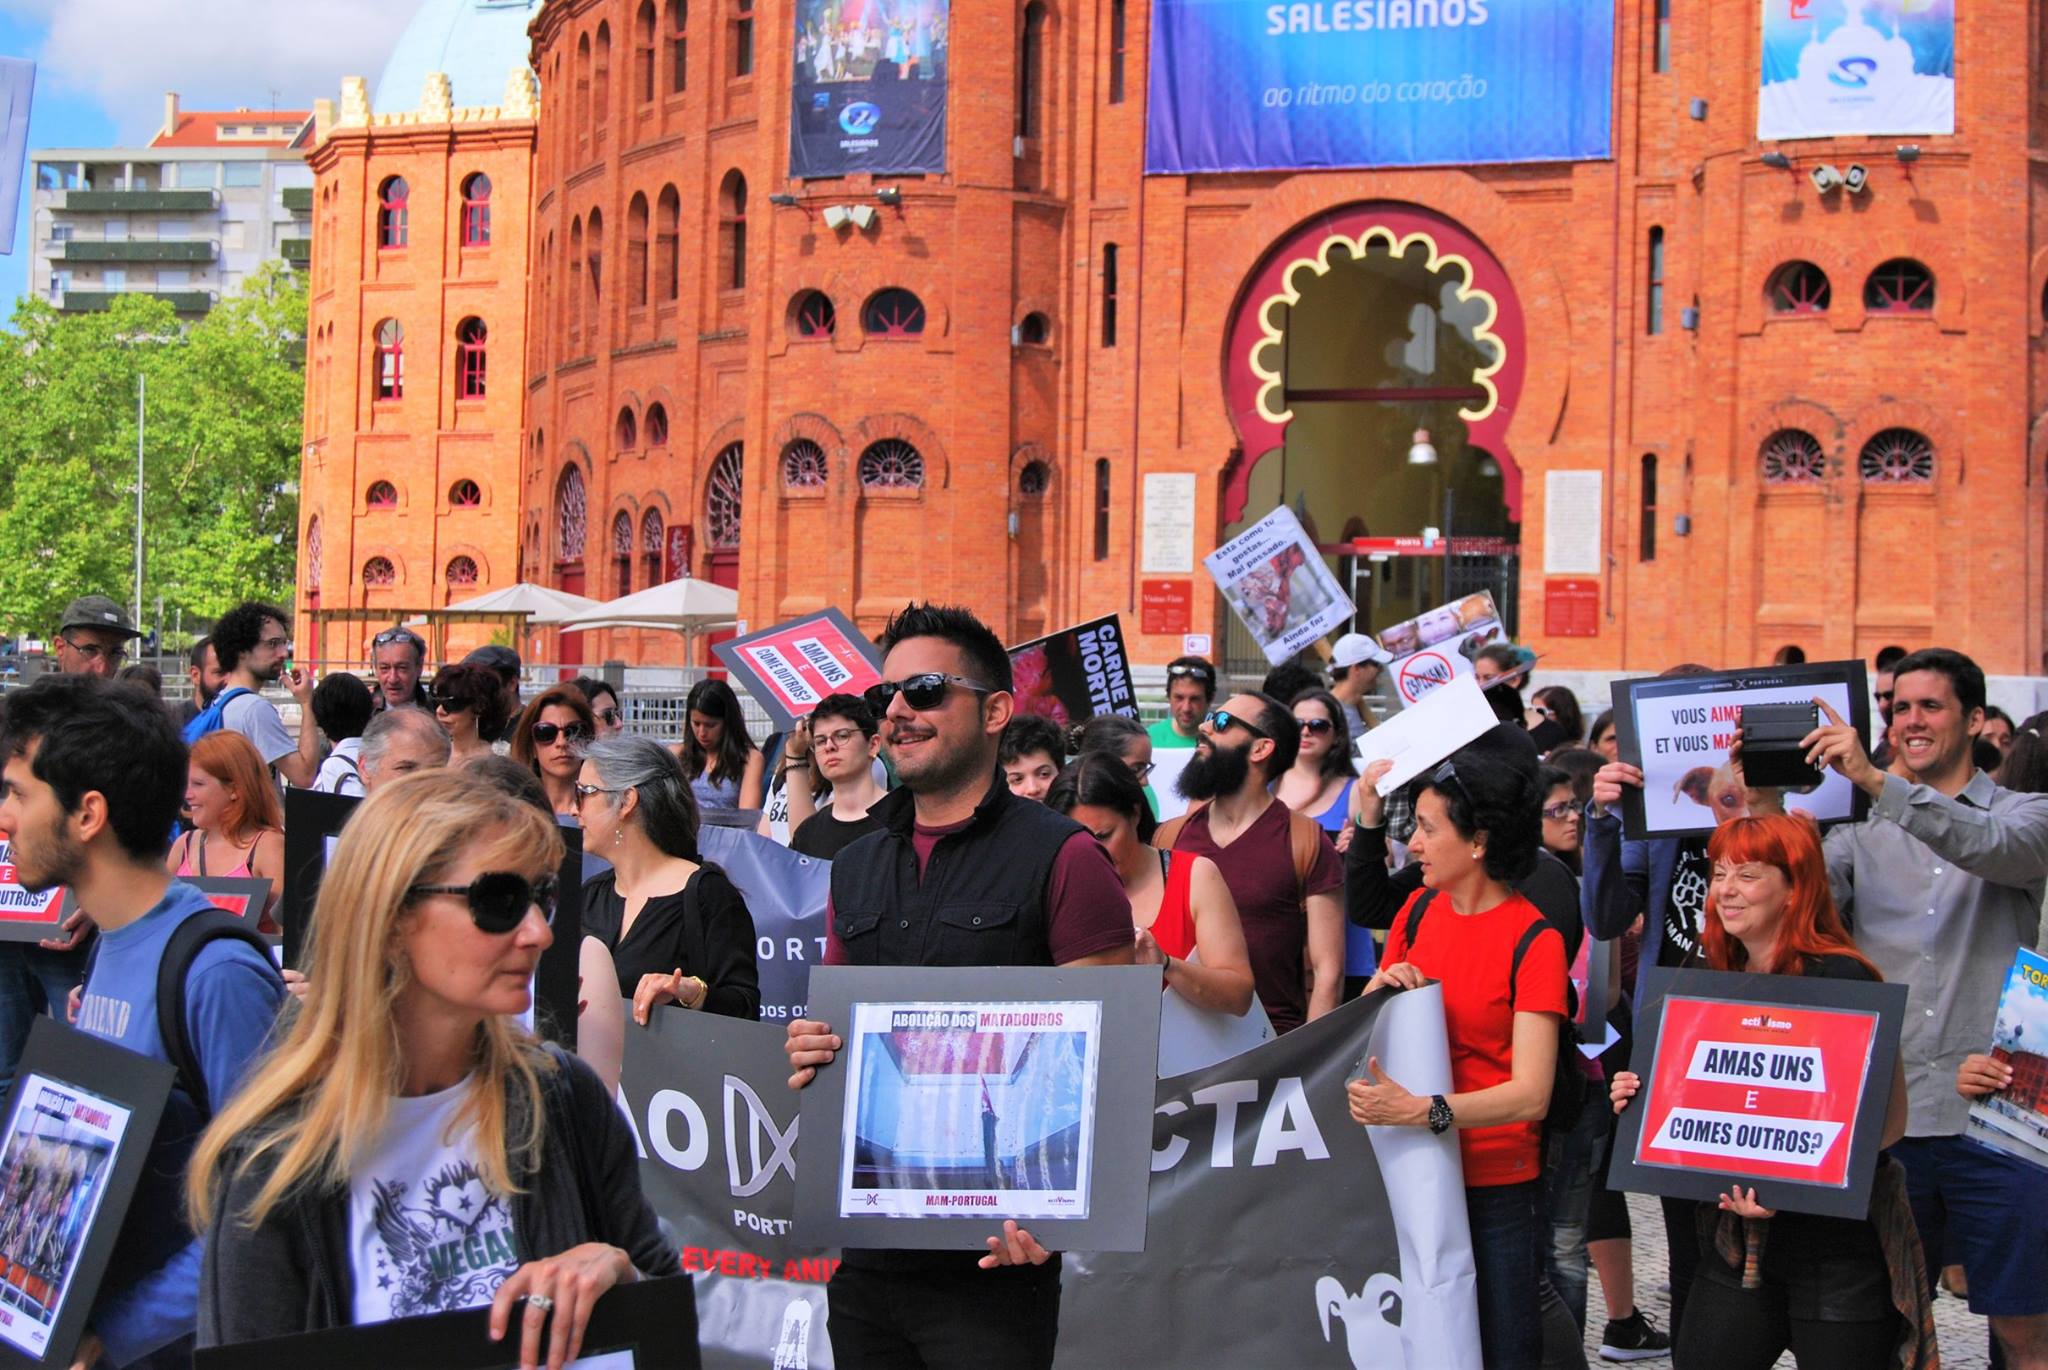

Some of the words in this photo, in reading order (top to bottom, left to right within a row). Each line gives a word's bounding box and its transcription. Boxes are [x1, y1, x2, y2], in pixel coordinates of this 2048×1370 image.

[1266, 0, 1489, 35] SALESIANOS
[1263, 87, 1293, 107] ao
[1296, 81, 1356, 105] ritmo
[1361, 80, 1391, 103] do
[1396, 74, 1488, 105] coração
[1238, 527, 1264, 545] como
[1227, 564, 1245, 579] Mal
[1283, 626, 1310, 645] Ainda
[756, 648, 783, 670] COME
[800, 642, 825, 663] AMA
[819, 658, 846, 683] UNS
[1098, 624, 1129, 704] CARNE
[1078, 630, 1113, 717] MORTE
[1671, 708, 1706, 725] VOUS
[1656, 738, 1670, 753] ET
[1674, 735, 1708, 752] VOUS
[3, 869, 13, 881] E
[893, 1011, 949, 1030] ABOLIÇÃO
[951, 1013, 976, 1027] DOS
[980, 1012, 1063, 1027] MATADOUROS
[1703, 1047, 1766, 1078] AMAS
[1769, 1054, 1815, 1083] UNS
[1744, 1089, 1760, 1109] E
[1669, 1117, 1733, 1146] COMES
[1736, 1124, 1824, 1155] OUTROS?
[926, 1194, 998, 1206] MAM-PORTUGAL
[734, 1209, 792, 1236] PORT
[681, 1246, 770, 1280] EVERY
